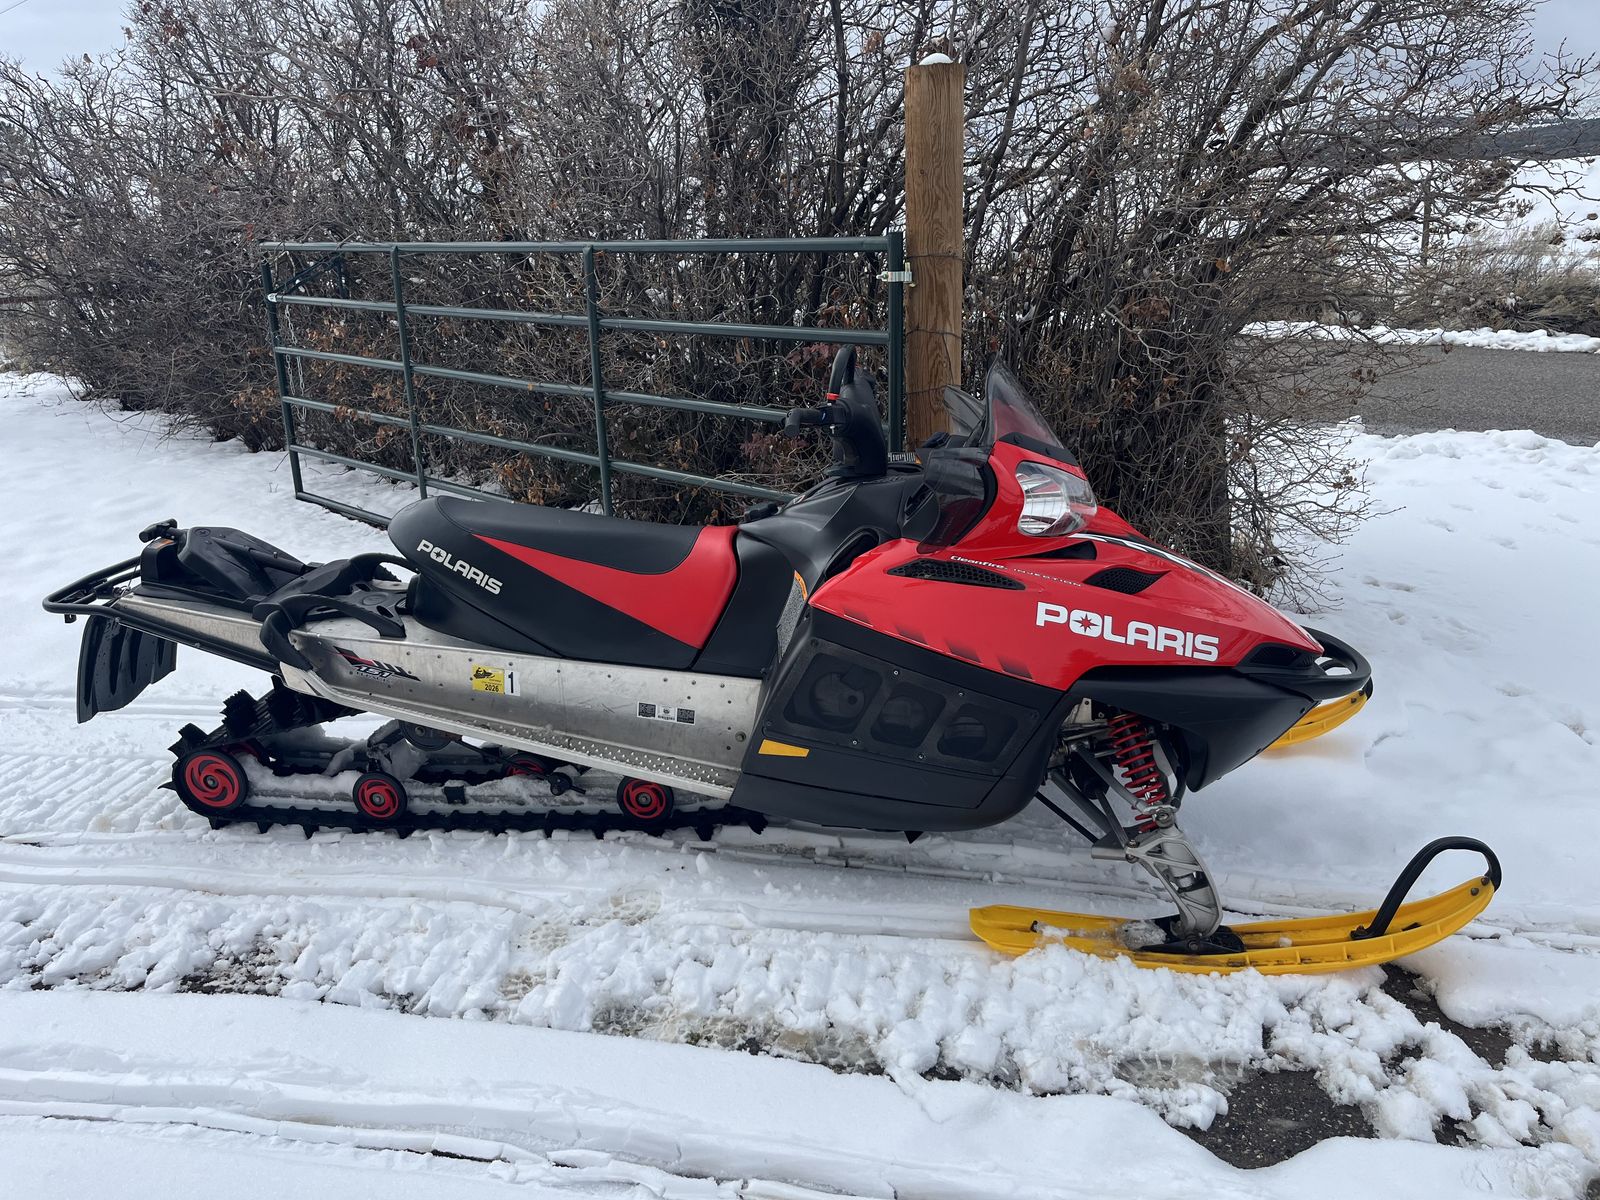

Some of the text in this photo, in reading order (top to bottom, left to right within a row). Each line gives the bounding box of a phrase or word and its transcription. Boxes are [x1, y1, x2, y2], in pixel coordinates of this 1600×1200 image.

[417, 539, 503, 595] POLARIS
[1036, 601, 1219, 662] POLARIS
[357, 665, 391, 678] 151
[508, 671, 514, 694] 1
[485, 684, 499, 692] 2026
